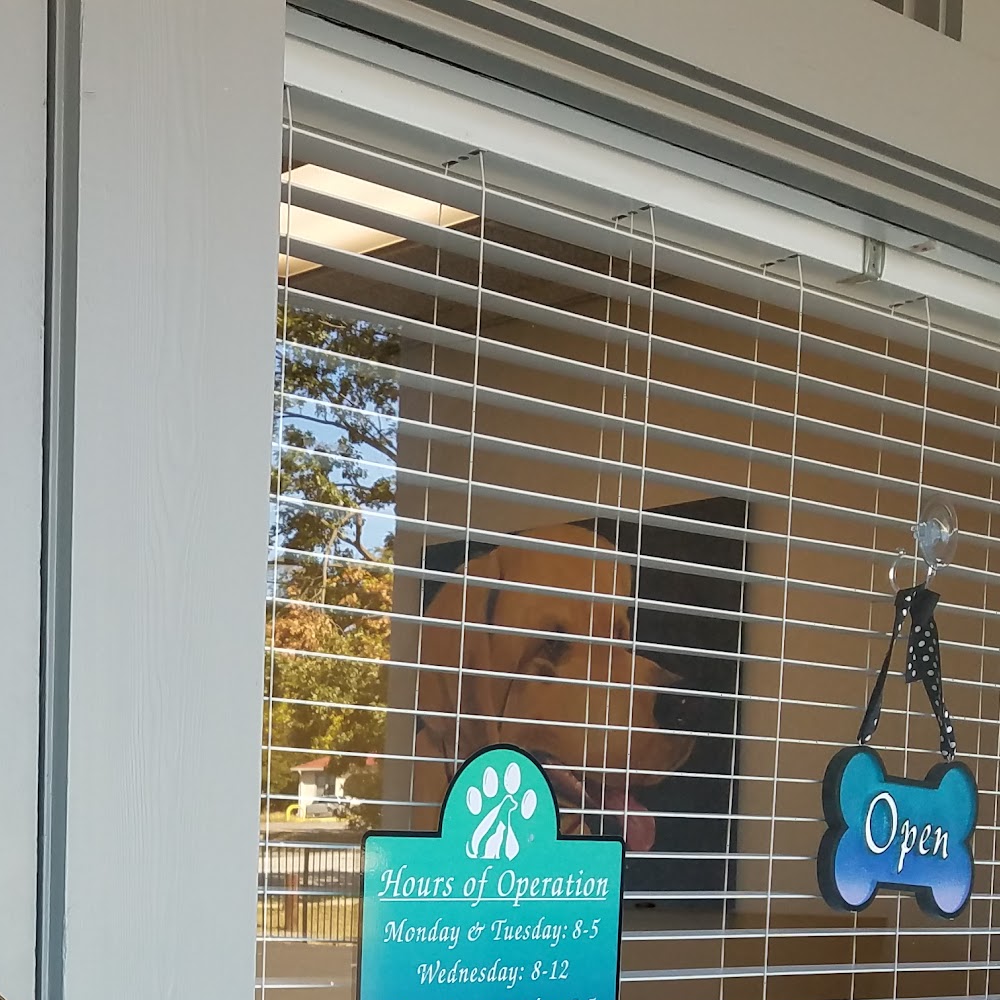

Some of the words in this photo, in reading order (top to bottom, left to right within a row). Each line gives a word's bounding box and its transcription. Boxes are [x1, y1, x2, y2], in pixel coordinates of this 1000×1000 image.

[865, 792, 949, 874] Open
[378, 865, 455, 899] Hours
[463, 865, 493, 907] of
[498, 869, 609, 907] Operation
[384, 918, 460, 949] Monday
[467, 921, 485, 941] &
[491, 917, 568, 947] Tuesday:
[572, 918, 600, 939] 8-5
[417, 959, 525, 988] Wednesday:
[531, 959, 570, 981] 8-12
